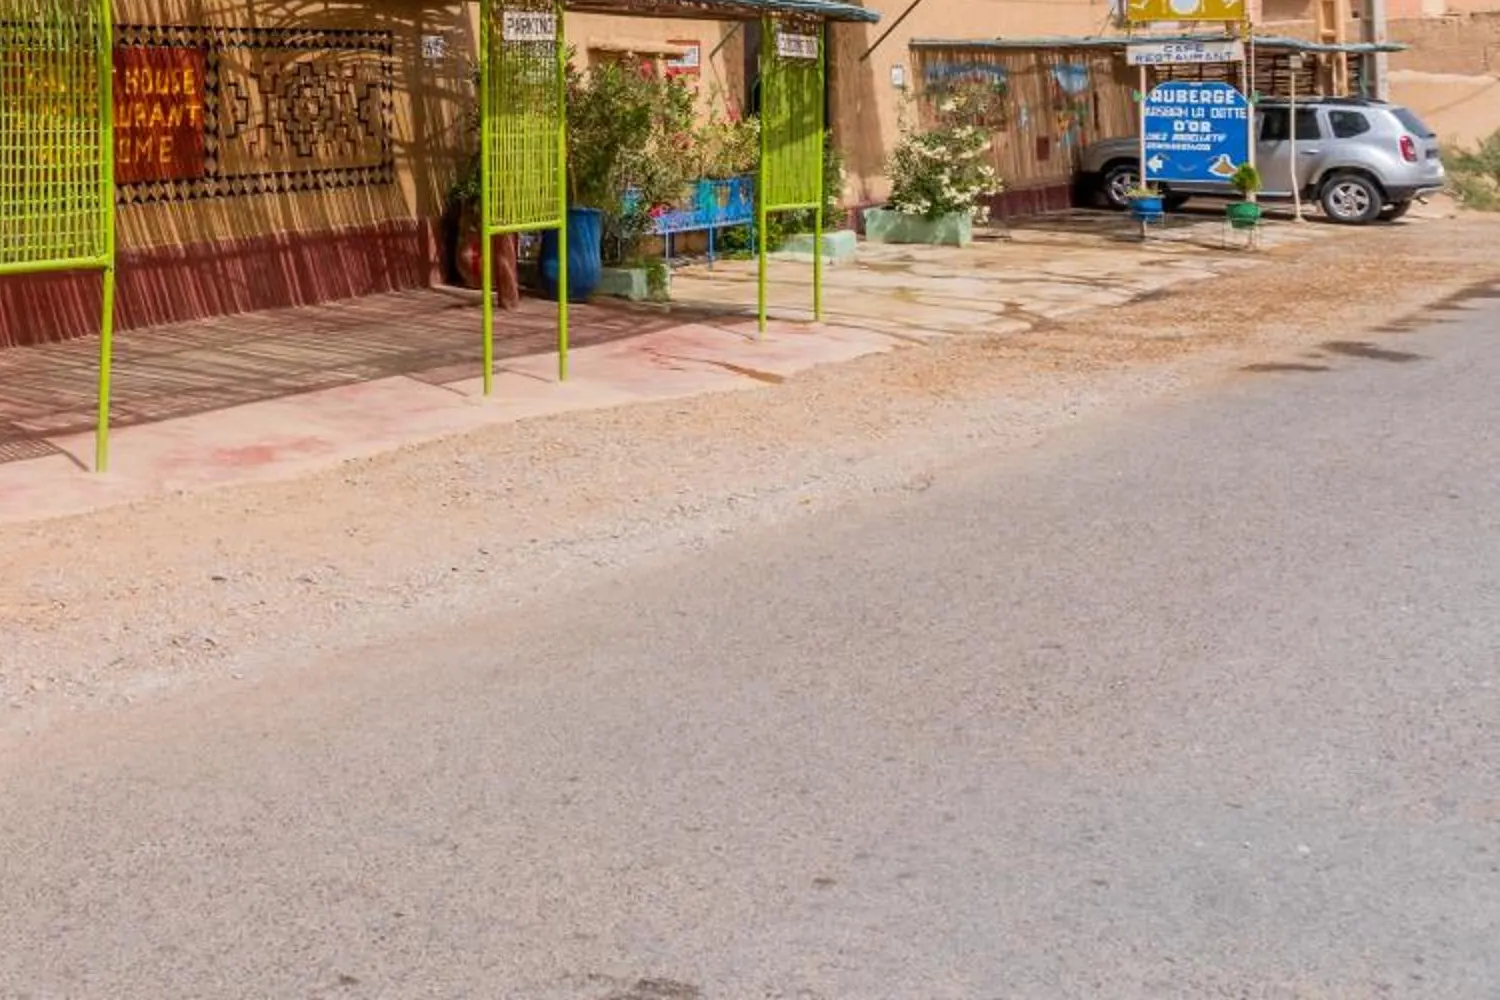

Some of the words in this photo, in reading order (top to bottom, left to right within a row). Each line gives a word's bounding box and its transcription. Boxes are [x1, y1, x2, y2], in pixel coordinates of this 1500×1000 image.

[125, 68, 196, 96] HOUSE
[1151, 89, 1236, 105] AUBERGE
[1191, 106, 1205, 118] LA
[1173, 119, 1212, 133] D'OR
